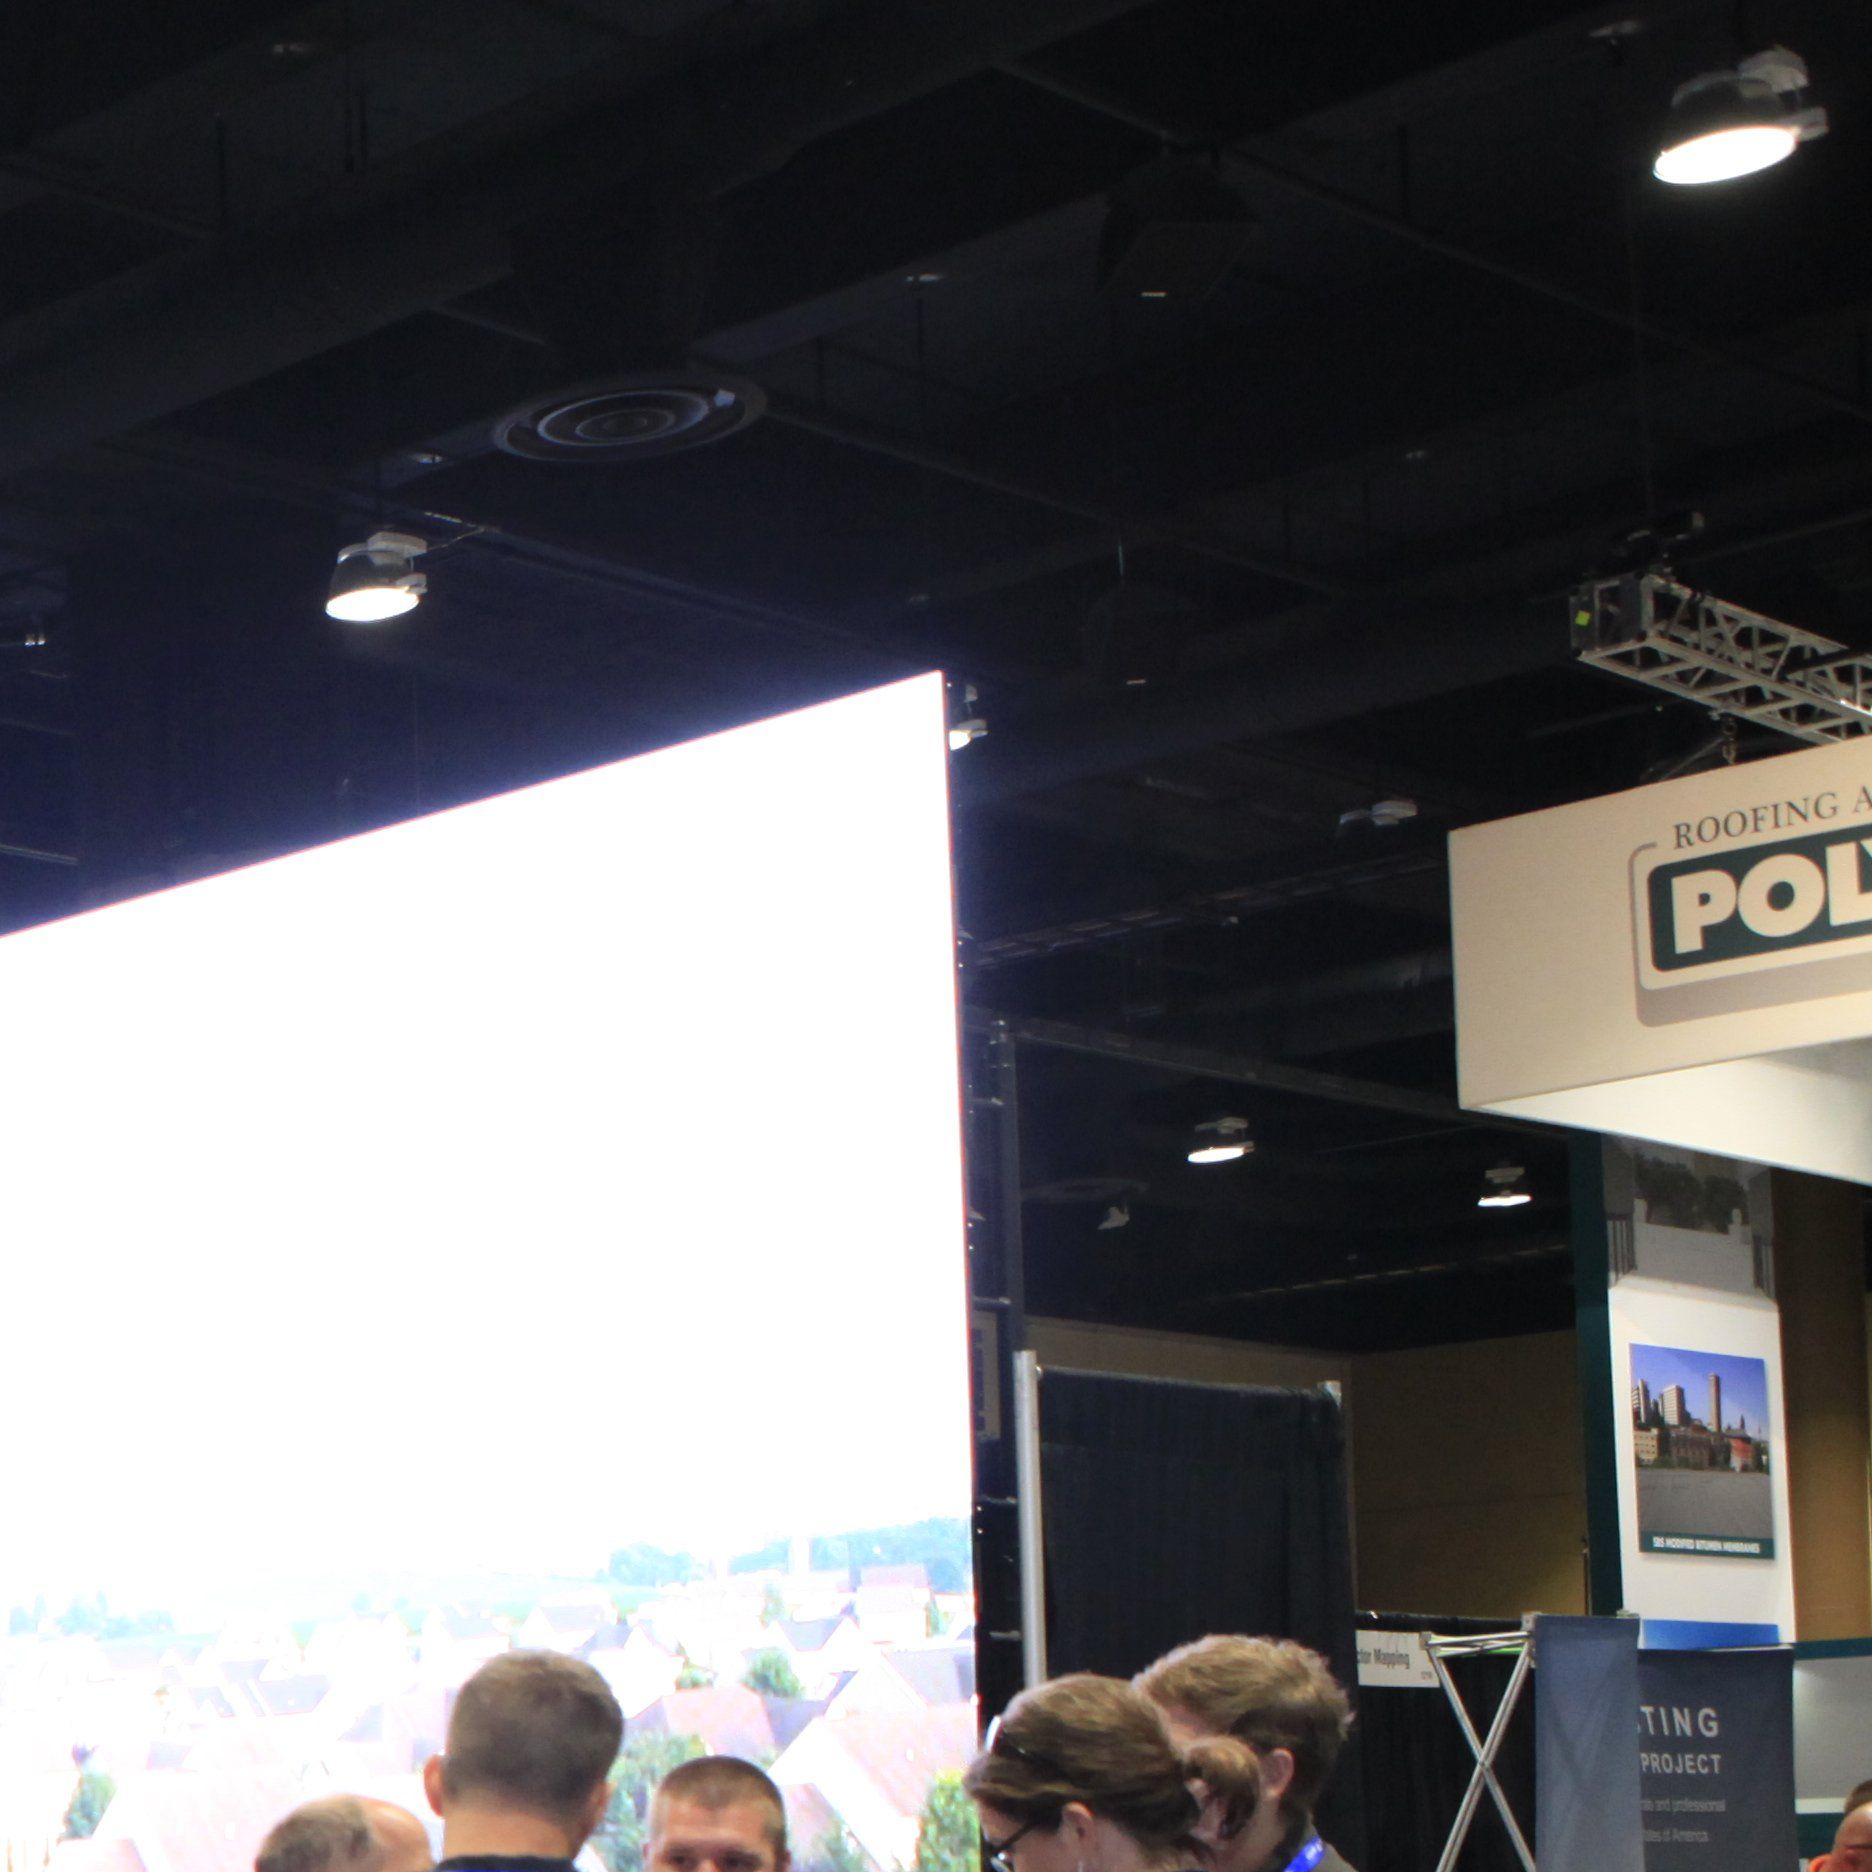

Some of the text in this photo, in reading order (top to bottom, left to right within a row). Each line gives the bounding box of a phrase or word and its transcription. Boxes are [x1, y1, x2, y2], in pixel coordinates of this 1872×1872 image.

[1672, 784, 1872, 851] ROOFING A
[1671, 838, 1872, 955] POL
[1638, 1705, 1719, 1738] TING
[1640, 1752, 1722, 1774] PROJECT
